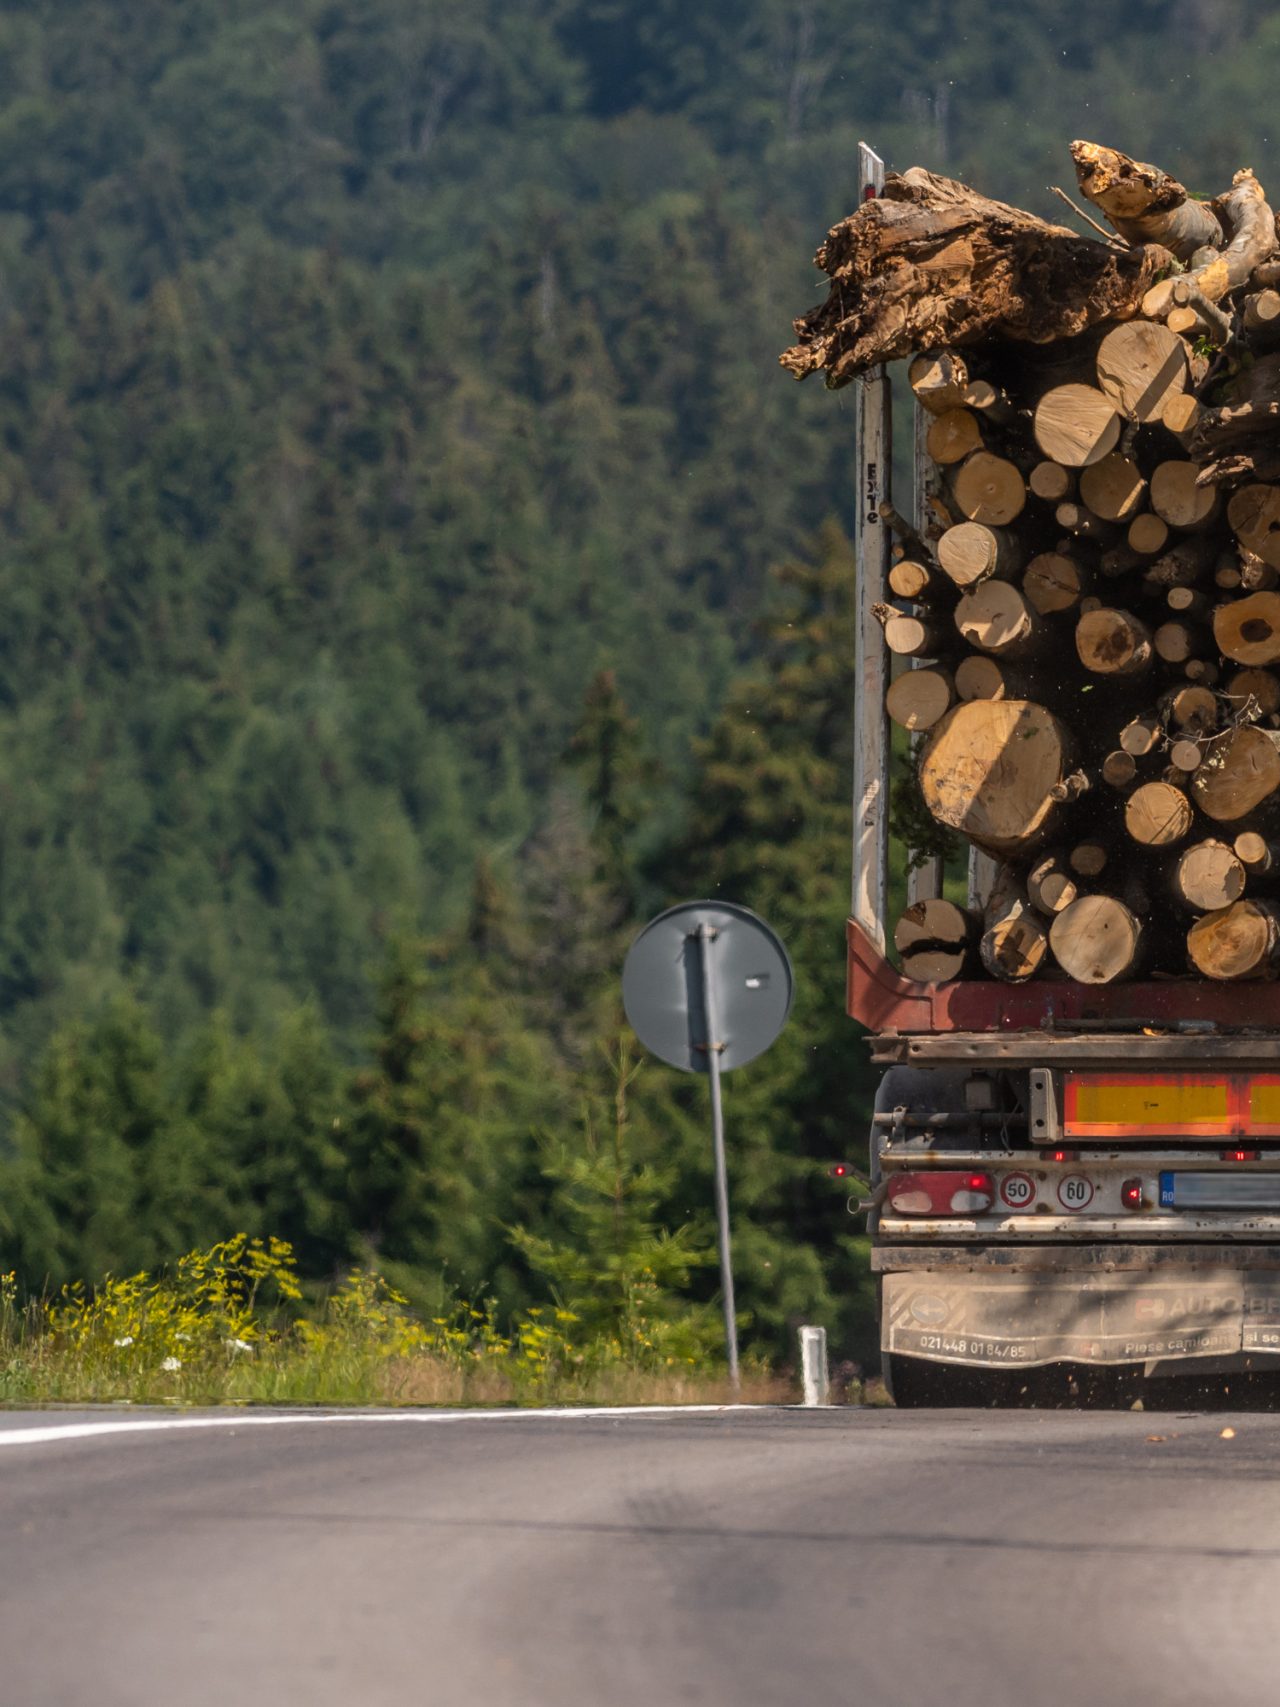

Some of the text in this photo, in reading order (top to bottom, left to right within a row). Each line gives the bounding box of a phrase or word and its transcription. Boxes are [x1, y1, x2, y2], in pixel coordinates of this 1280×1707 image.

[1007, 1183, 1027, 1198] 50
[1067, 1181, 1085, 1200] 60
[1162, 1191, 1174, 1202] RO
